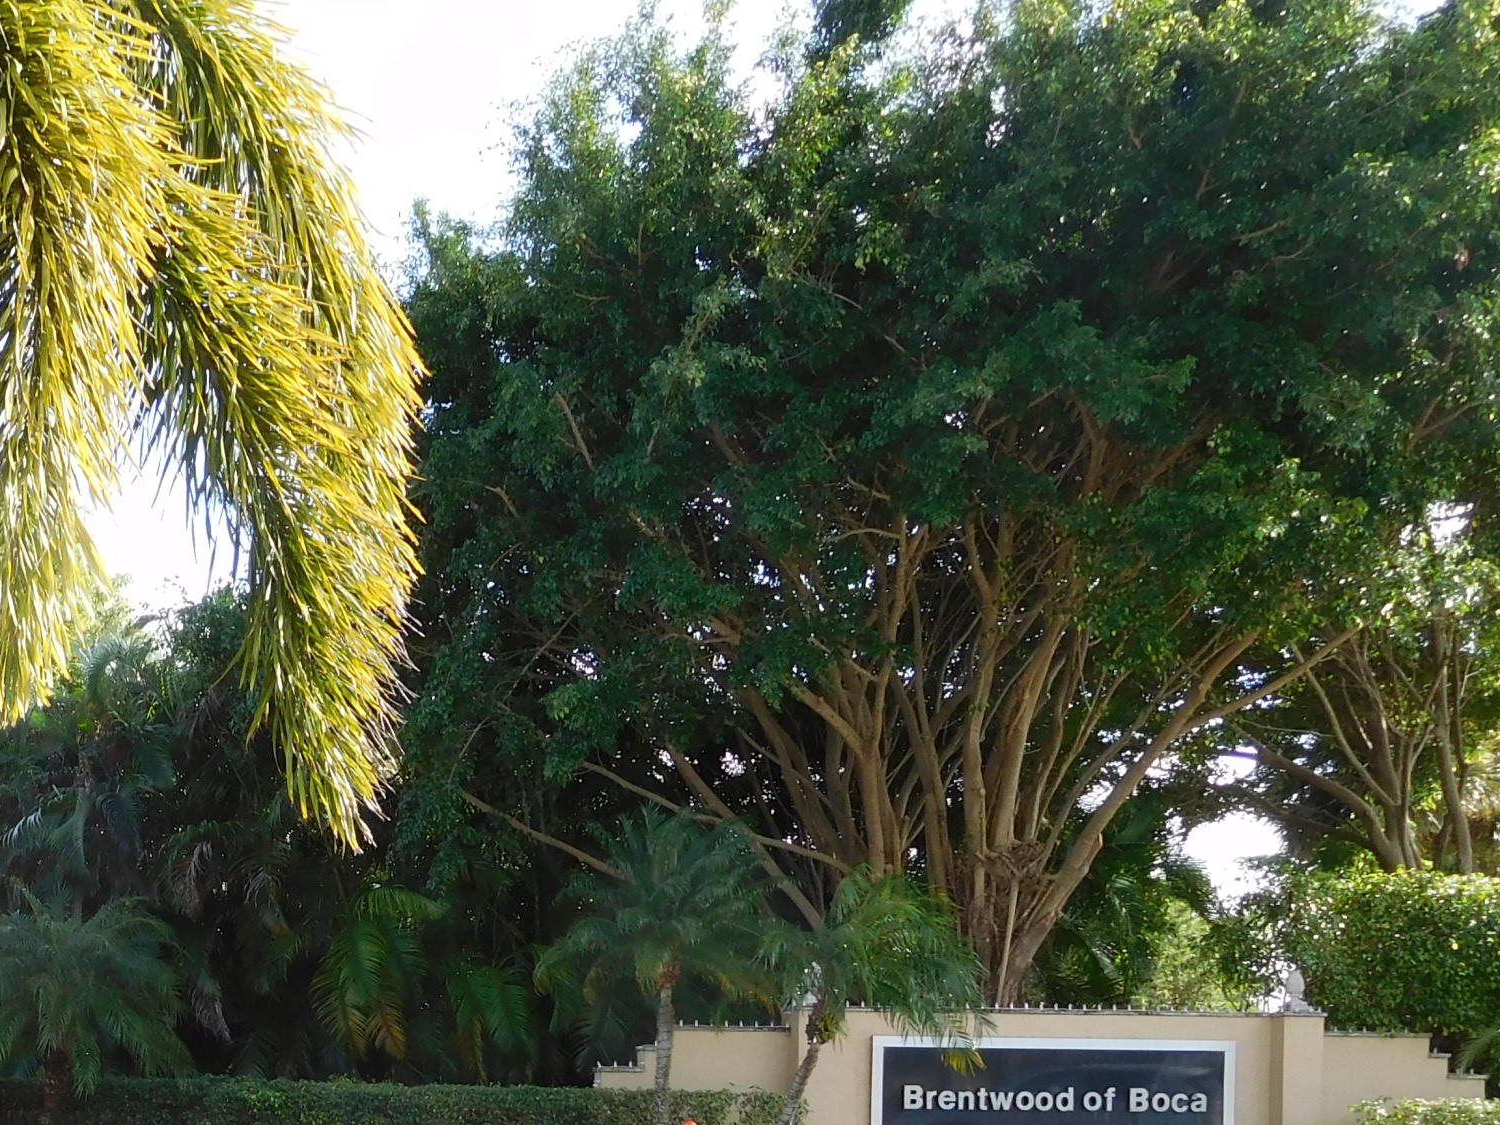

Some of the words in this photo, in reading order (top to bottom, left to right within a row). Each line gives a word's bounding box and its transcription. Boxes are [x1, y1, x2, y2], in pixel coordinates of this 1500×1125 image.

[902, 1084, 1075, 1112] Brentwood
[1082, 1086, 1117, 1112] of
[1128, 1087, 1209, 1113] Boca
